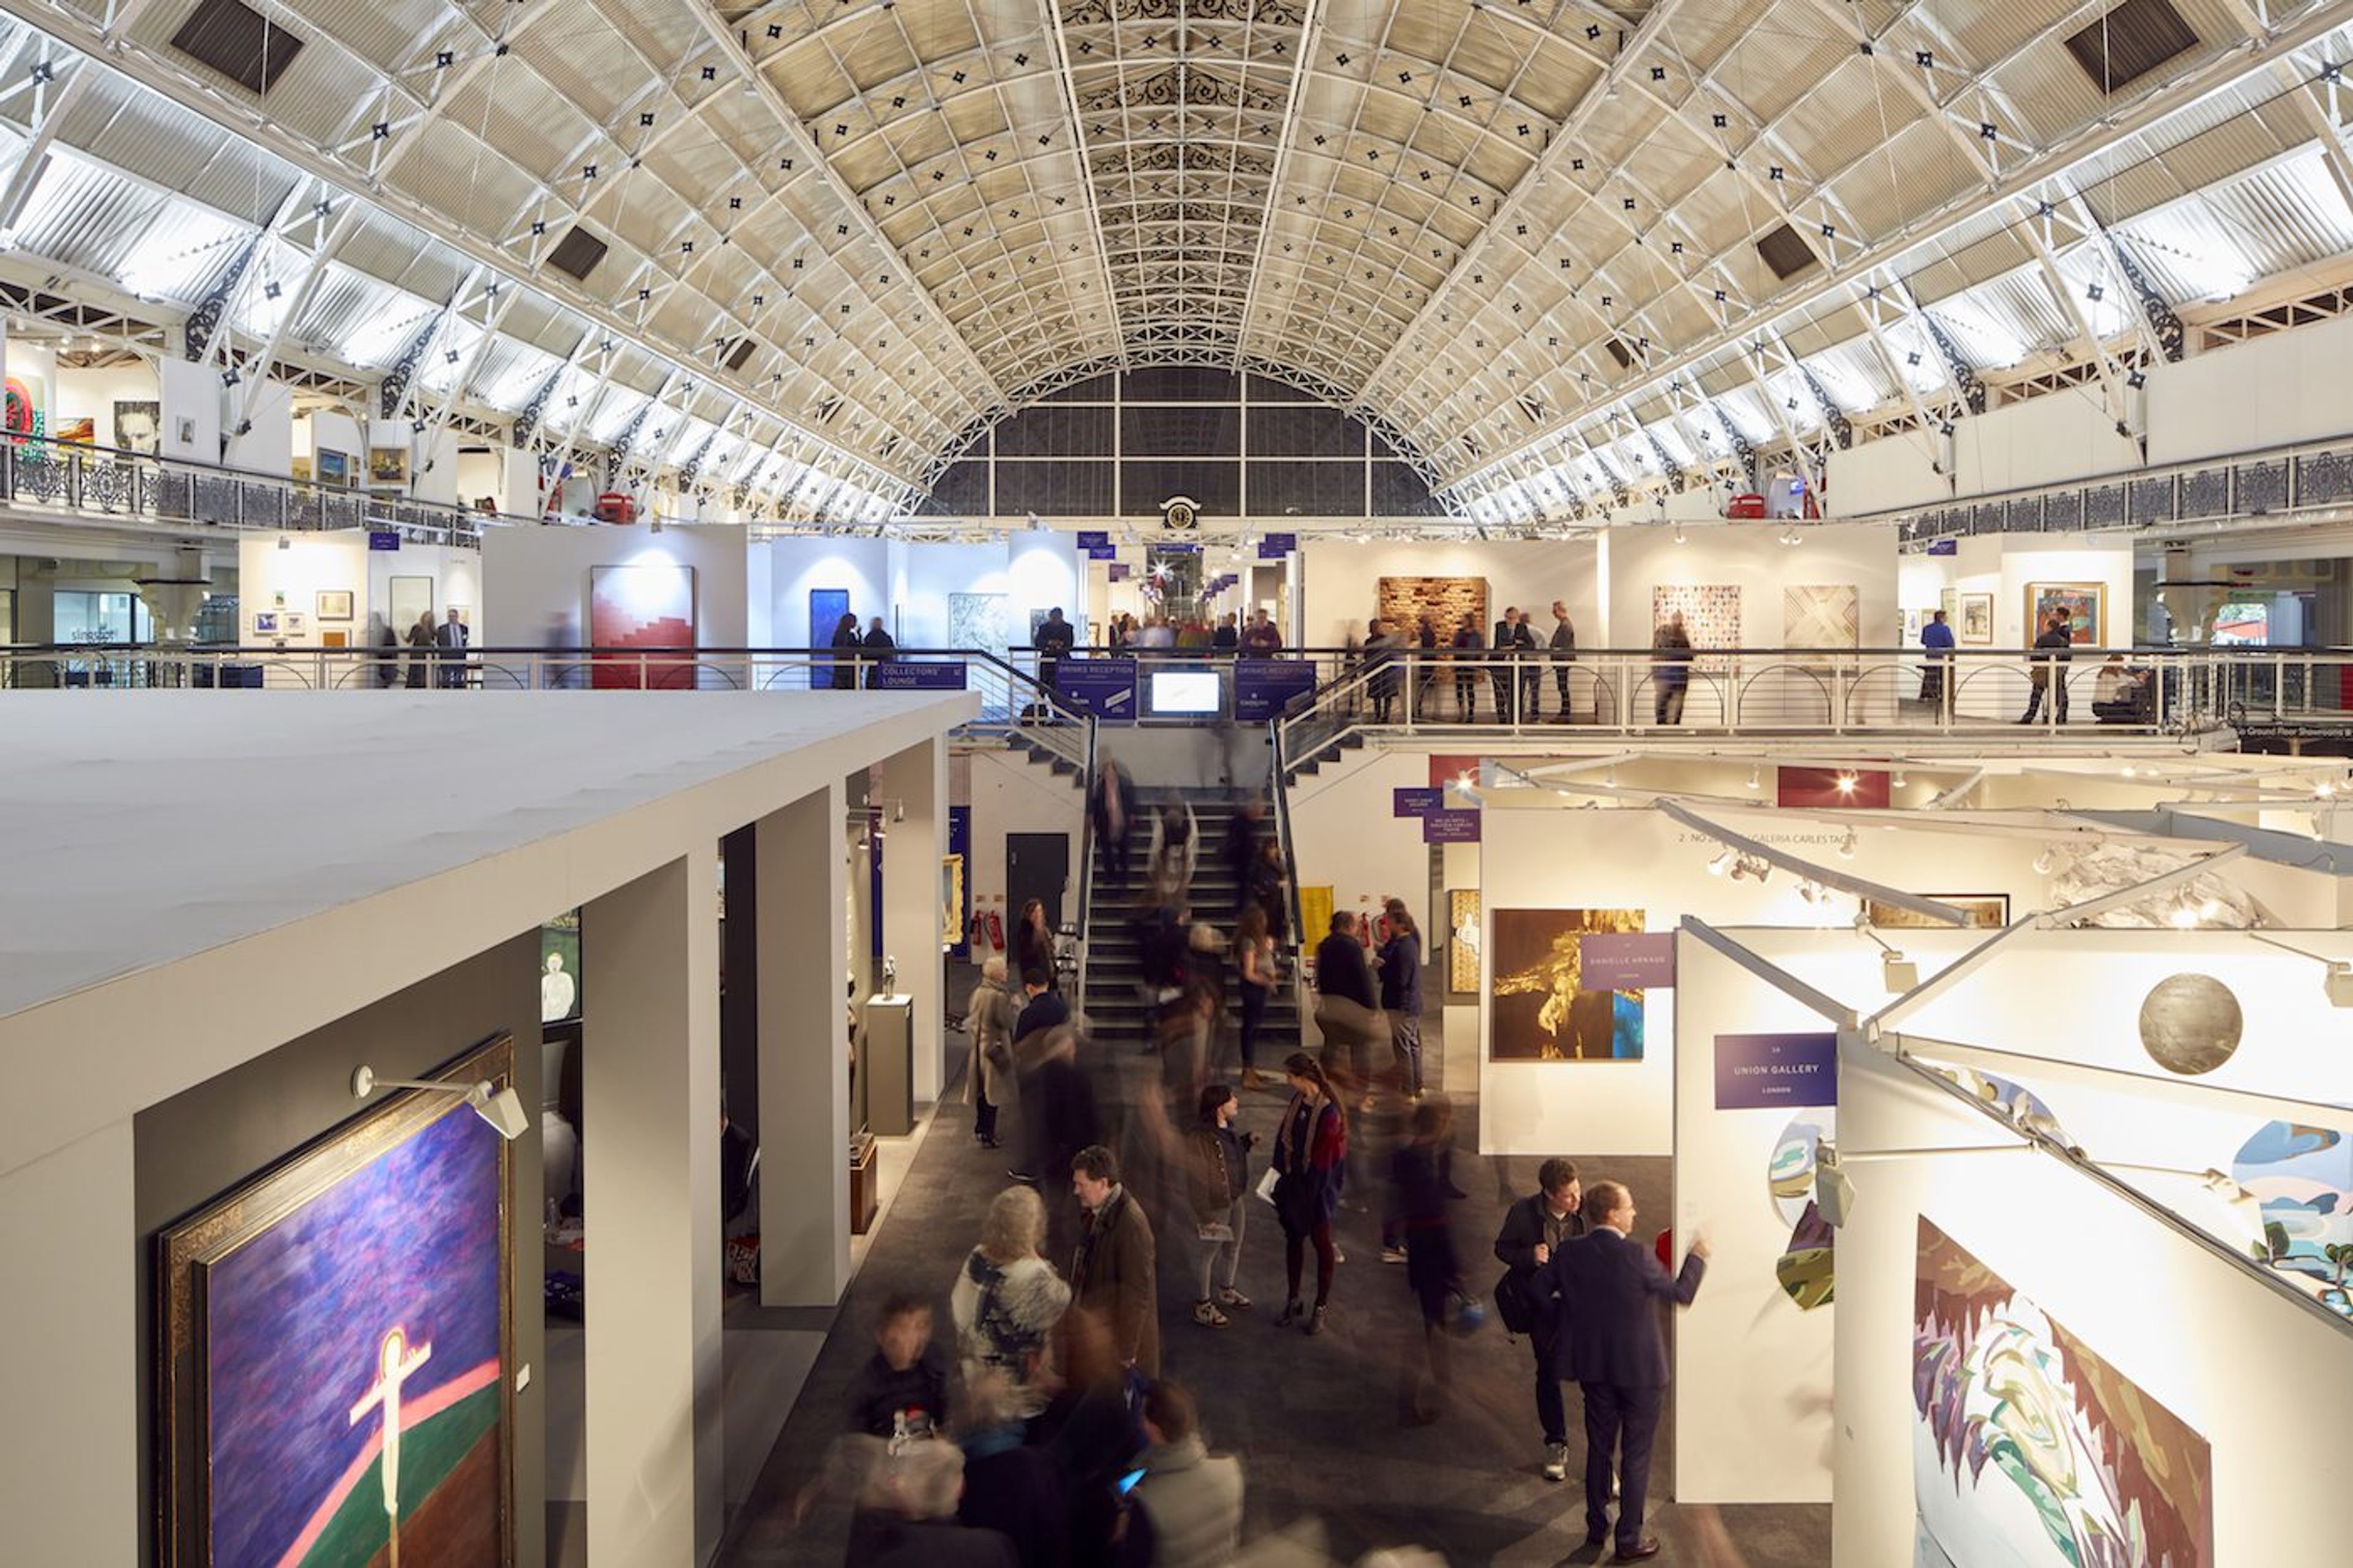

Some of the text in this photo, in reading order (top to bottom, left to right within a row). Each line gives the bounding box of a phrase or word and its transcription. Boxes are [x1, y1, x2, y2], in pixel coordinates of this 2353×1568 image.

[1058, 665, 1134, 674] DRINKS RECEPTION
[1793, 833, 1828, 844] CARLES
[1734, 1064, 1819, 1075] UNION GALLERY
